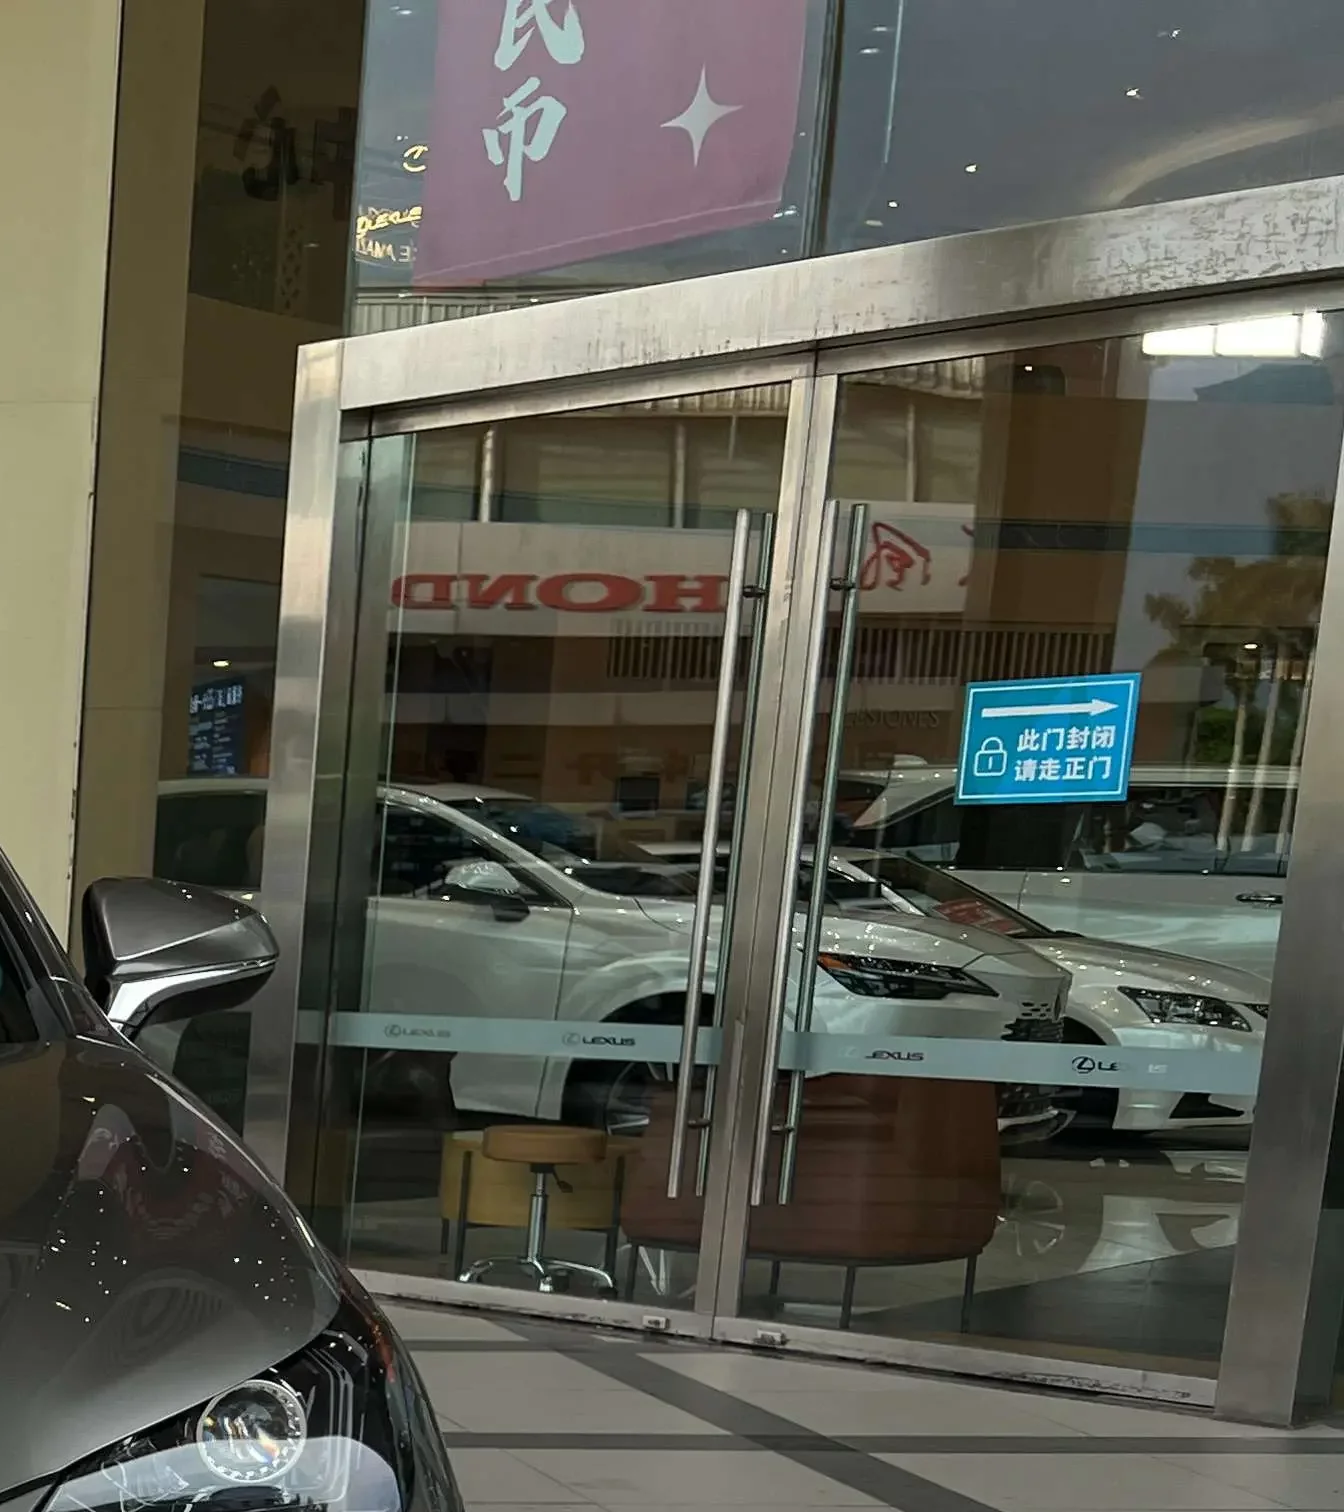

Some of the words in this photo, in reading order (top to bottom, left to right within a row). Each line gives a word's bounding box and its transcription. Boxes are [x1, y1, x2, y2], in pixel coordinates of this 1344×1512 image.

[1016, 724, 1116, 752] 此门封闭
[1014, 755, 1112, 782] 请走正门
[582, 1035, 636, 1047] LEXUS
